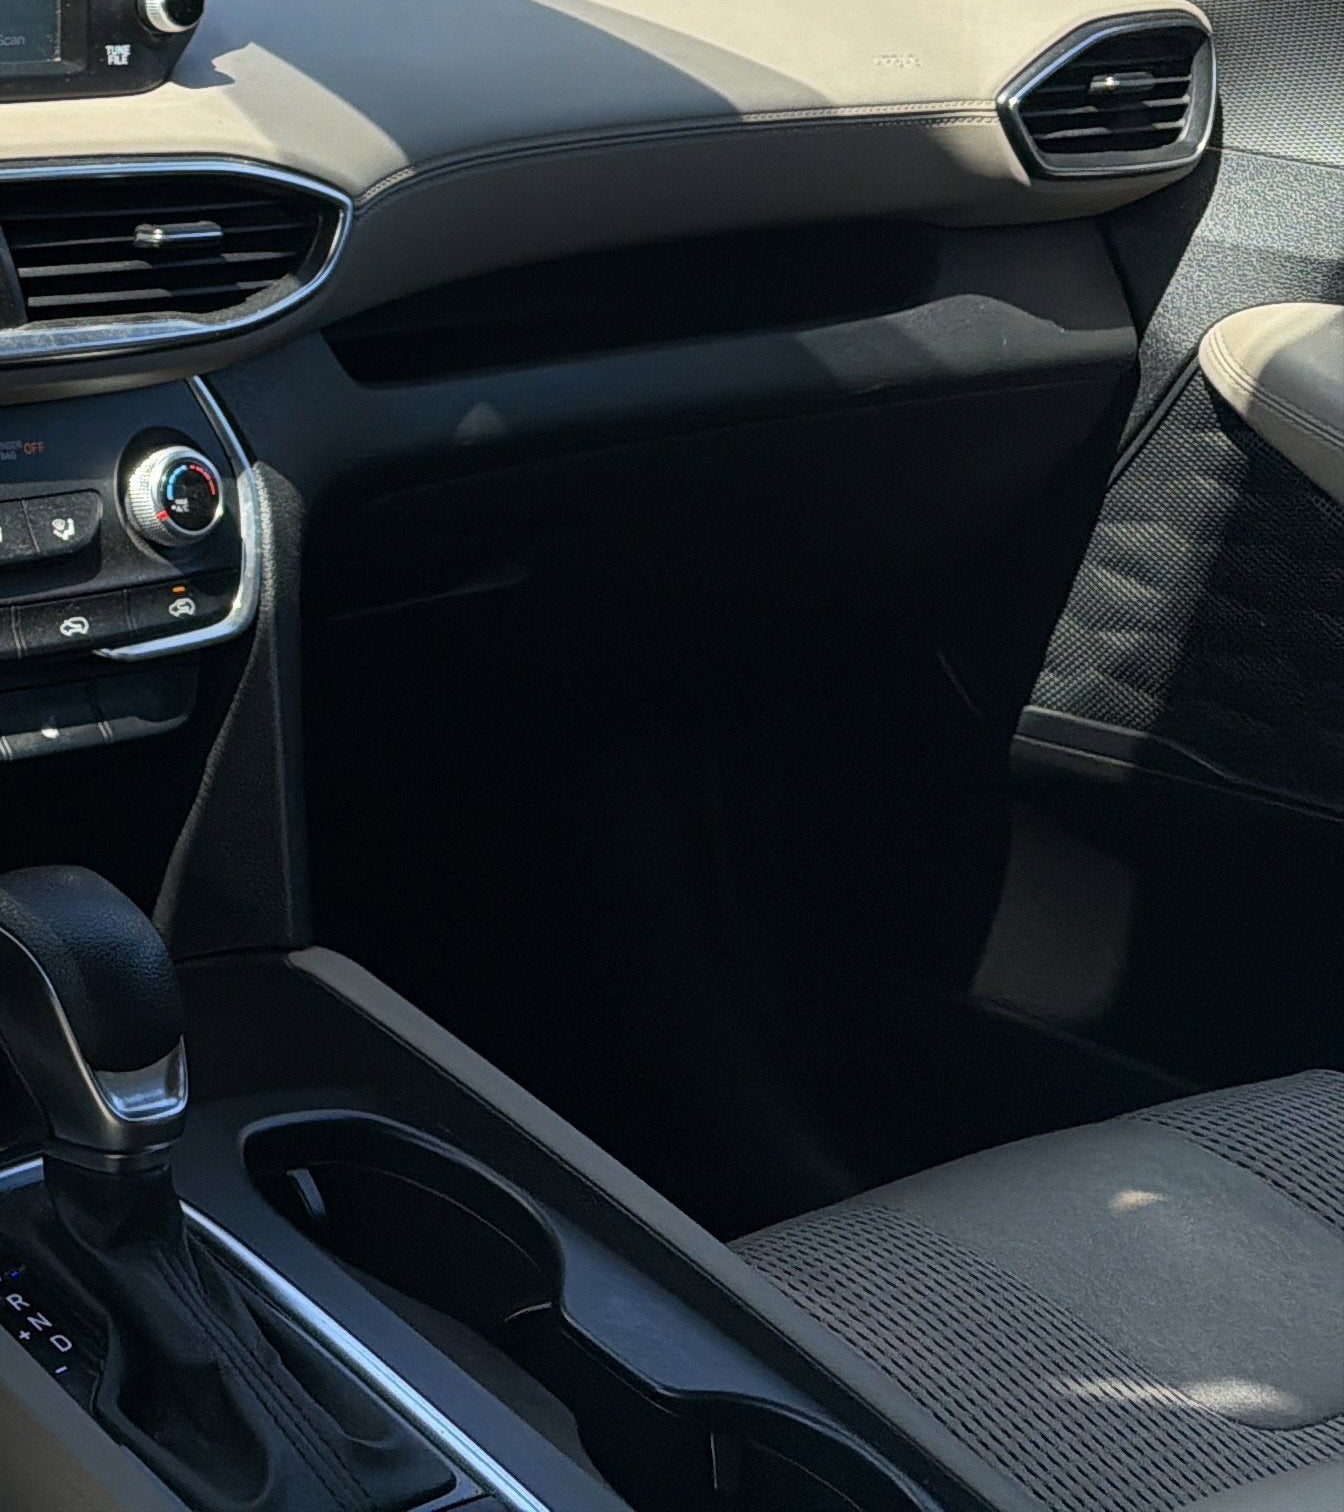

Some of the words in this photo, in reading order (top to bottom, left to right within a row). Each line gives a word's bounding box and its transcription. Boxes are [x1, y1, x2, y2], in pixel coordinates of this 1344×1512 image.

[105, 45, 131, 56] TUNE
[107, 55, 129, 66] FILE
[23, 442, 45, 455] OFF
[5, 1293, 31, 1311] R
[26, 1312, 53, 1331] N
[49, 1335, 72, 1352] D
